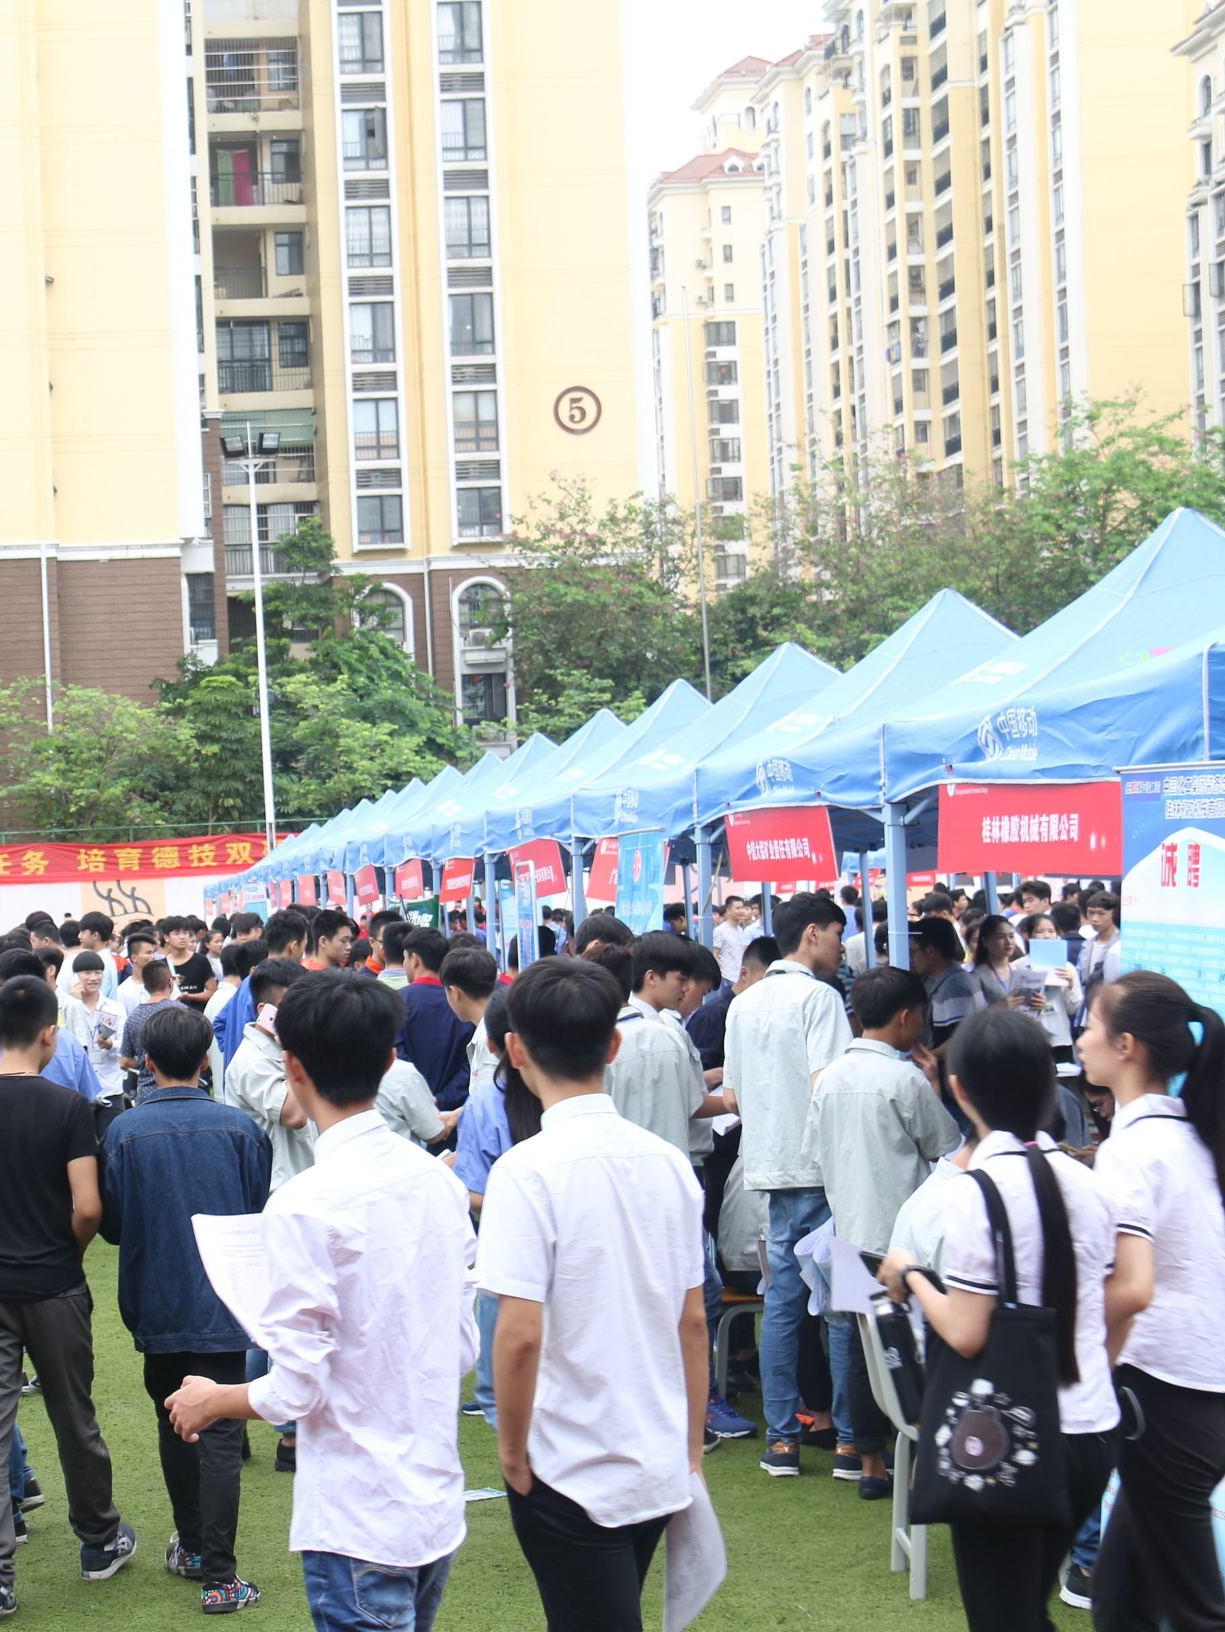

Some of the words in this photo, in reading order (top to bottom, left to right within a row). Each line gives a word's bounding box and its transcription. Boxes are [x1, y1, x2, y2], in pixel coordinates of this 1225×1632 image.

[569, 397, 586, 424] 5
[982, 813, 1079, 843] 桂林橡胶机械有限公司
